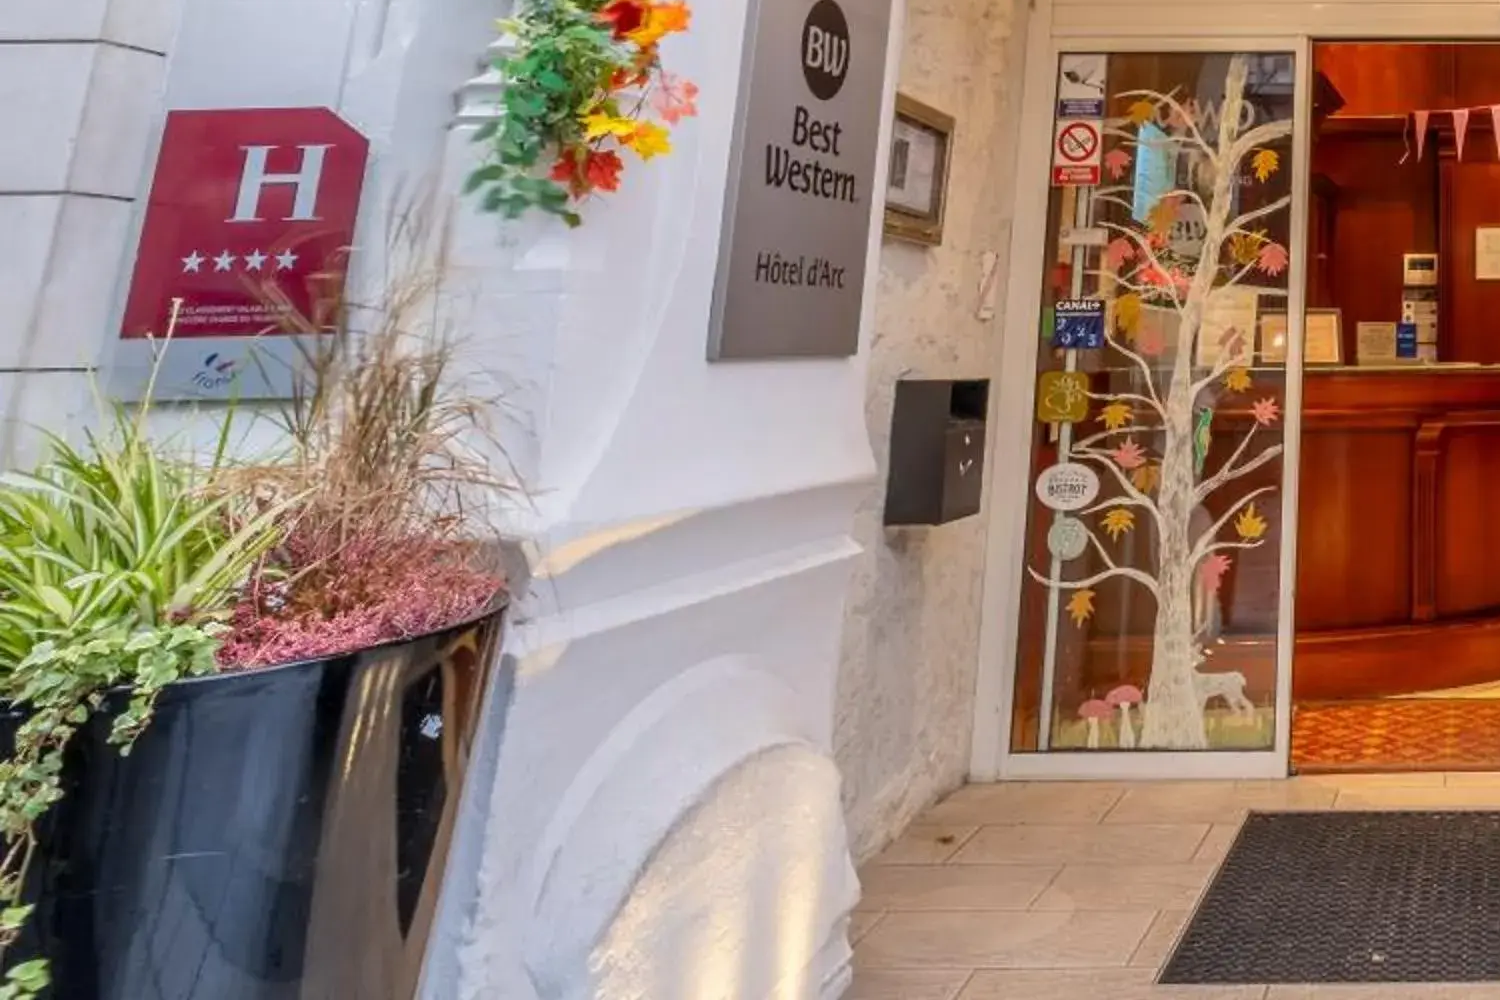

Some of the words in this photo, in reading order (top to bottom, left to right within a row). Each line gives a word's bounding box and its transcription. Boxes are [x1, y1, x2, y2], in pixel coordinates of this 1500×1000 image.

[805, 24, 847, 78] BW
[792, 105, 843, 157] Best
[223, 143, 337, 224] H
[765, 144, 856, 203] Western
[755, 251, 804, 287] Hôtel
[807, 256, 845, 290] d'Arc
[1055, 300, 1101, 311] CANAL+
